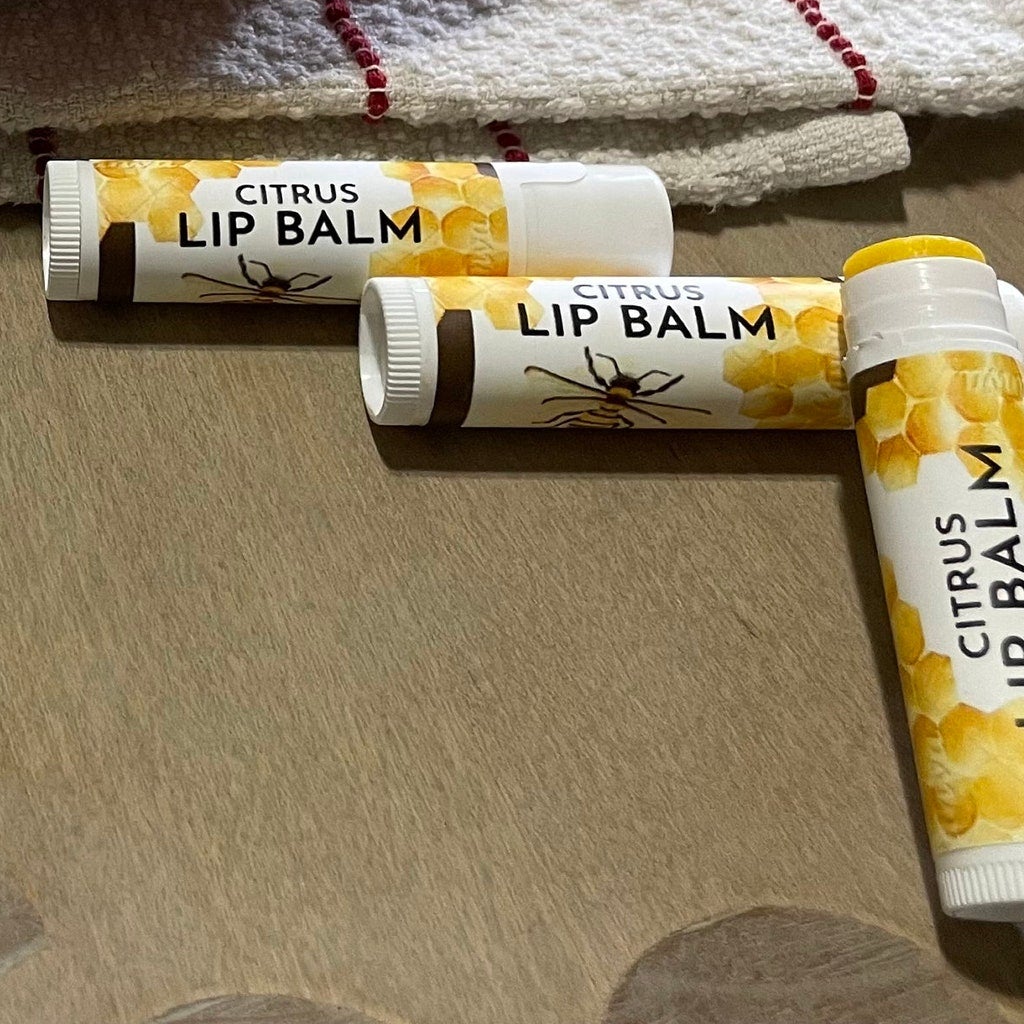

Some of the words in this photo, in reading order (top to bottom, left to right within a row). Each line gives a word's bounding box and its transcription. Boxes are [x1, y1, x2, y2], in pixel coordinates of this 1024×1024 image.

[235, 183, 360, 206] CITRUS
[179, 210, 256, 248] LIP
[276, 206, 422, 246] BALM
[573, 284, 705, 302] CITRUS
[517, 303, 599, 337] LIP
[621, 304, 776, 340] BALM
[959, 444, 1024, 609] BALM
[936, 513, 990, 658] CITRUS
